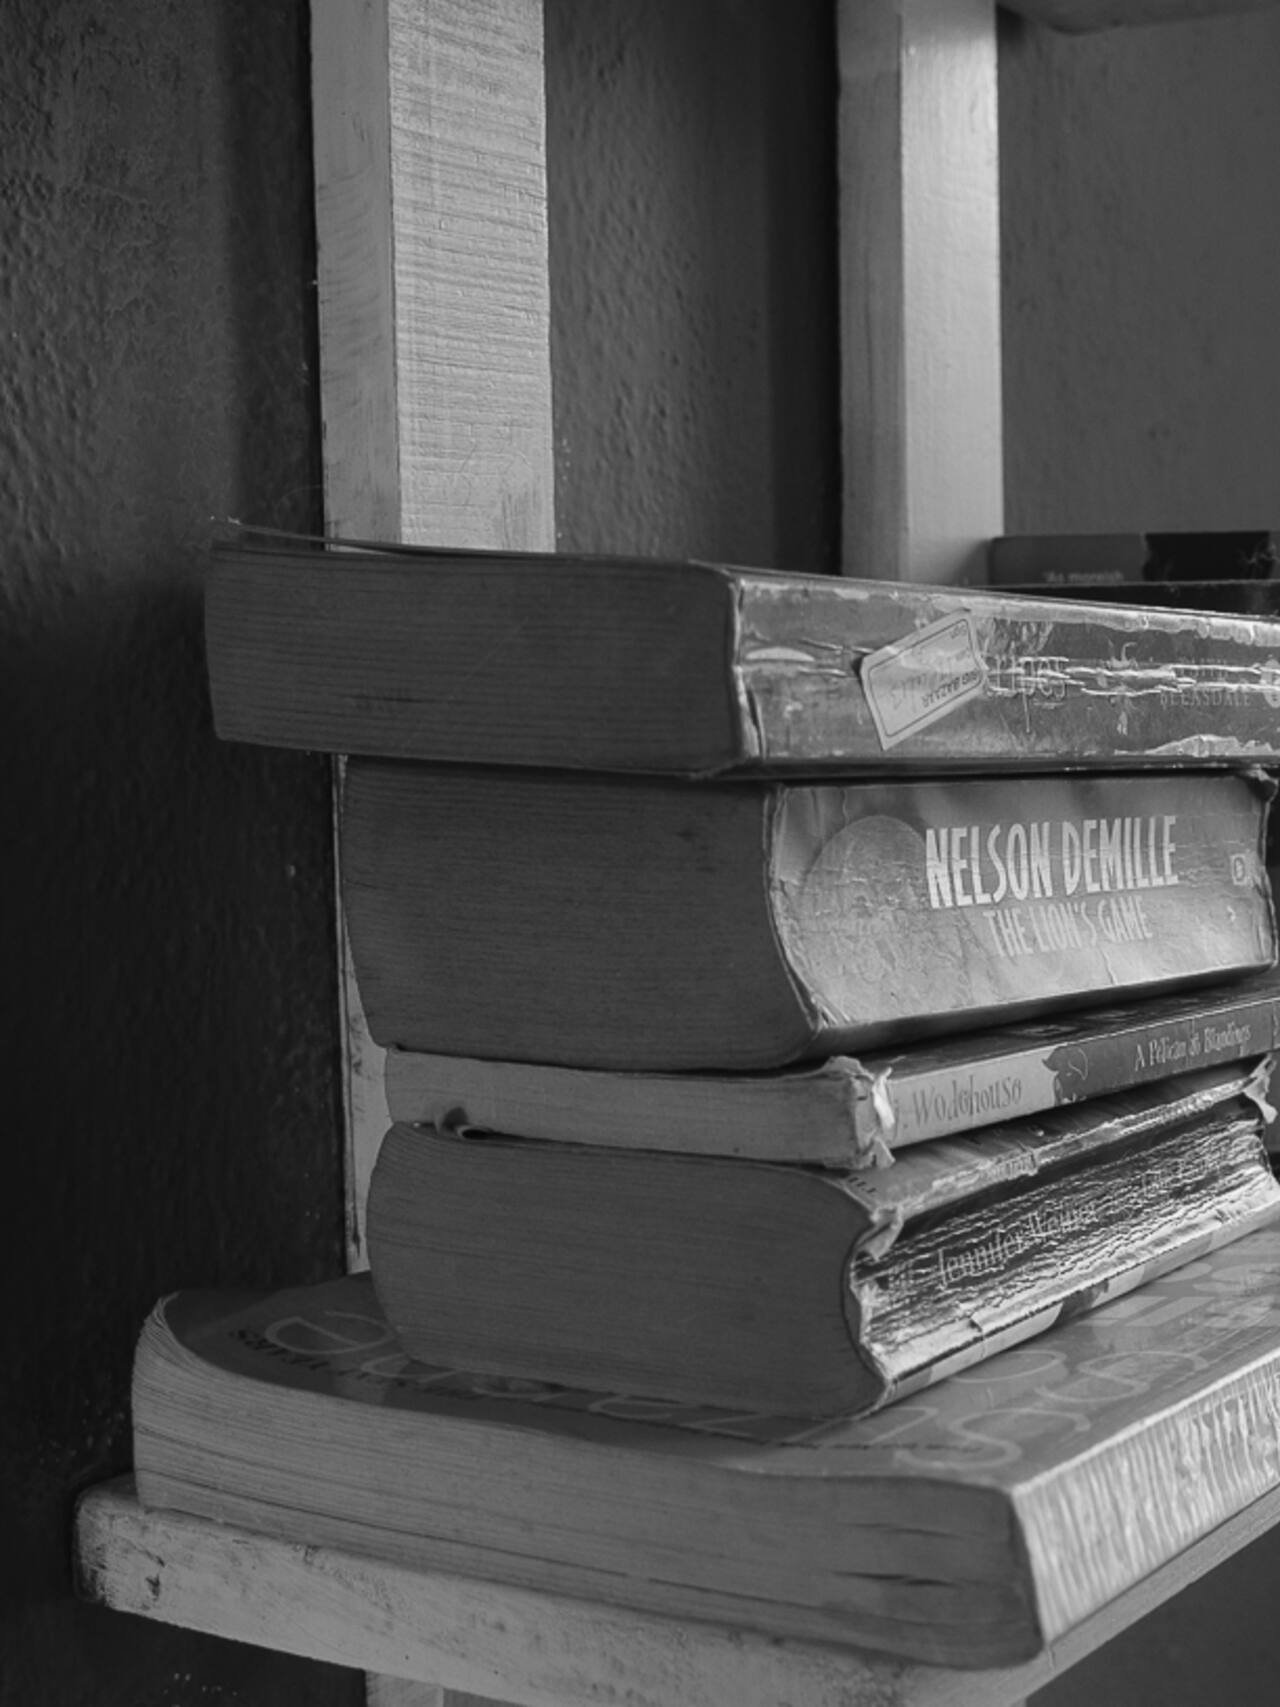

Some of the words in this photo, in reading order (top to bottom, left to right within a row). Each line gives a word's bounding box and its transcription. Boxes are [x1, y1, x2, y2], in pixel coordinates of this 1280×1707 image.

[925, 821, 1053, 910] NELSON
[1062, 814, 1179, 897] DEMILLE
[983, 909, 1031, 958] THE
[1028, 901, 1099, 957] LION'S
[1099, 895, 1154, 944] GAME
[1134, 1044, 1148, 1072] A
[1148, 1038, 1188, 1068] Pelican
[1203, 1021, 1253, 1062] Blandings
